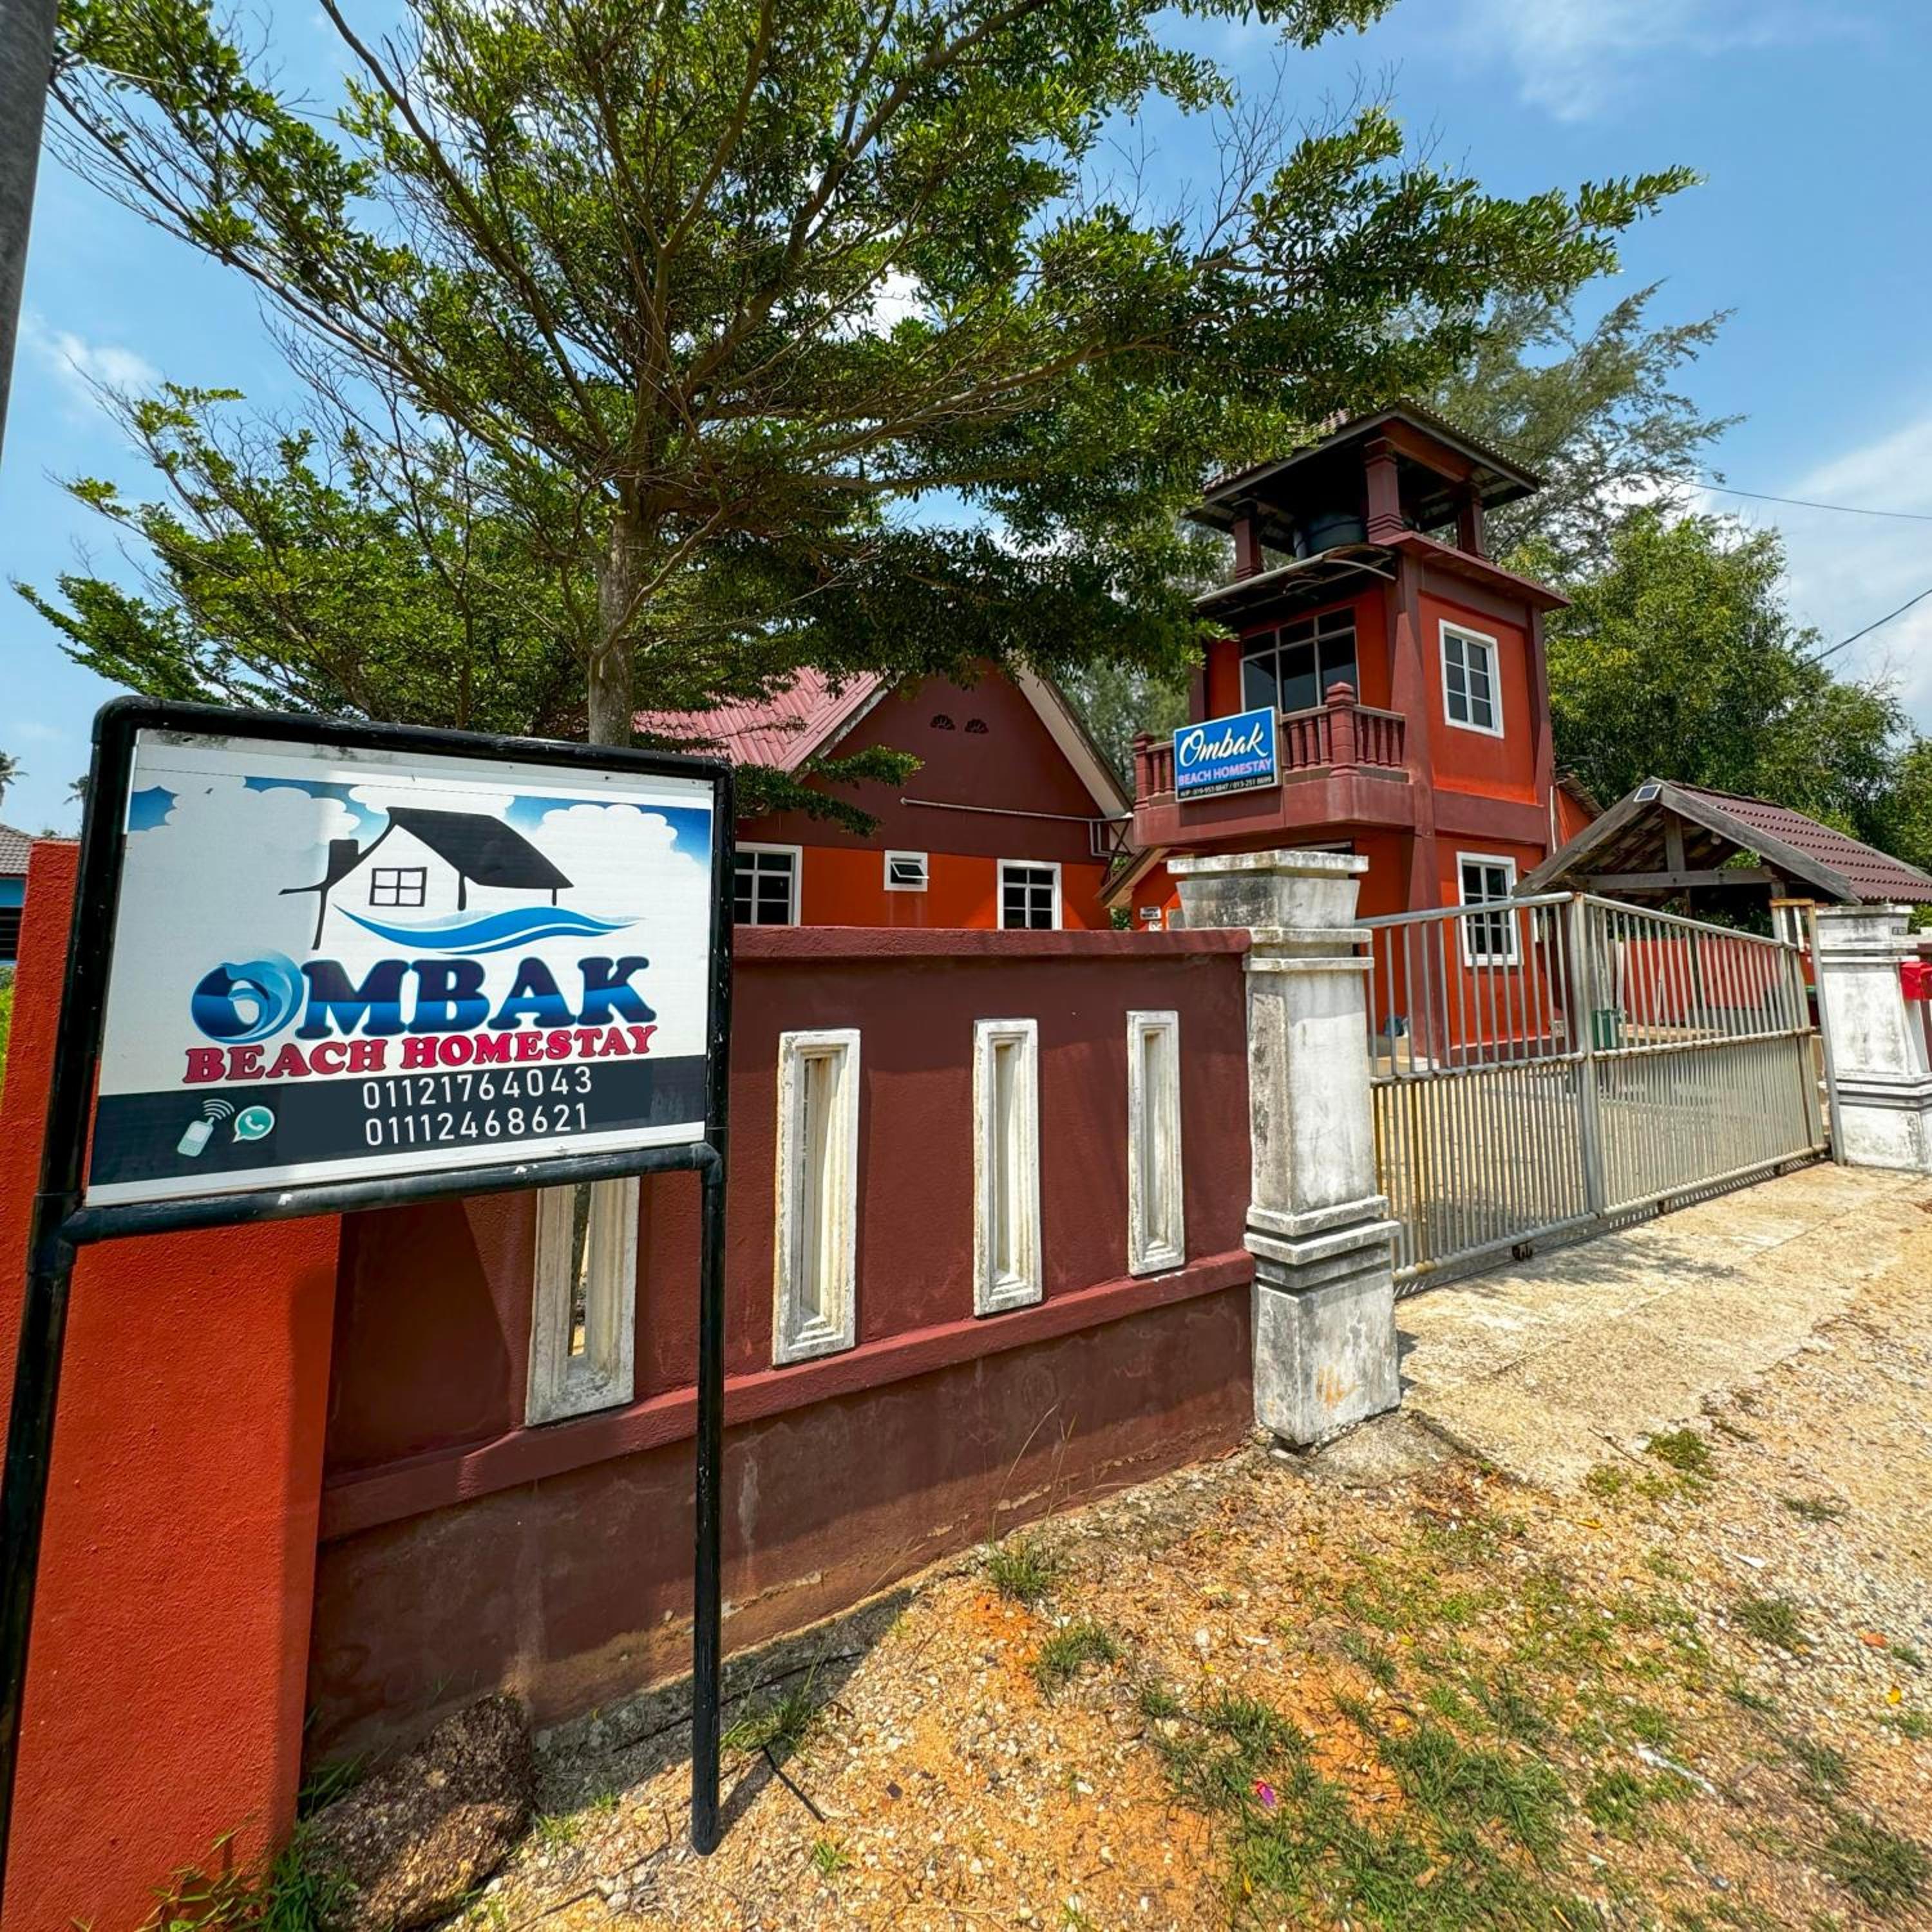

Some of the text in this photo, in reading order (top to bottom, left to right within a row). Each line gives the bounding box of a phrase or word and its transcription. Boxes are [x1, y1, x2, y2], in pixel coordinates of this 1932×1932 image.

[1179, 722, 1269, 767] Ombak
[1178, 769, 1211, 786] BEACH
[1213, 758, 1272, 780] HOMESTAY
[191, 953, 657, 1045] OMBAK
[182, 1025, 658, 1084] BEACH HOMESTAY
[363, 1066, 592, 1110] 01121764043
[365, 1103, 587, 1147] 01112468621
